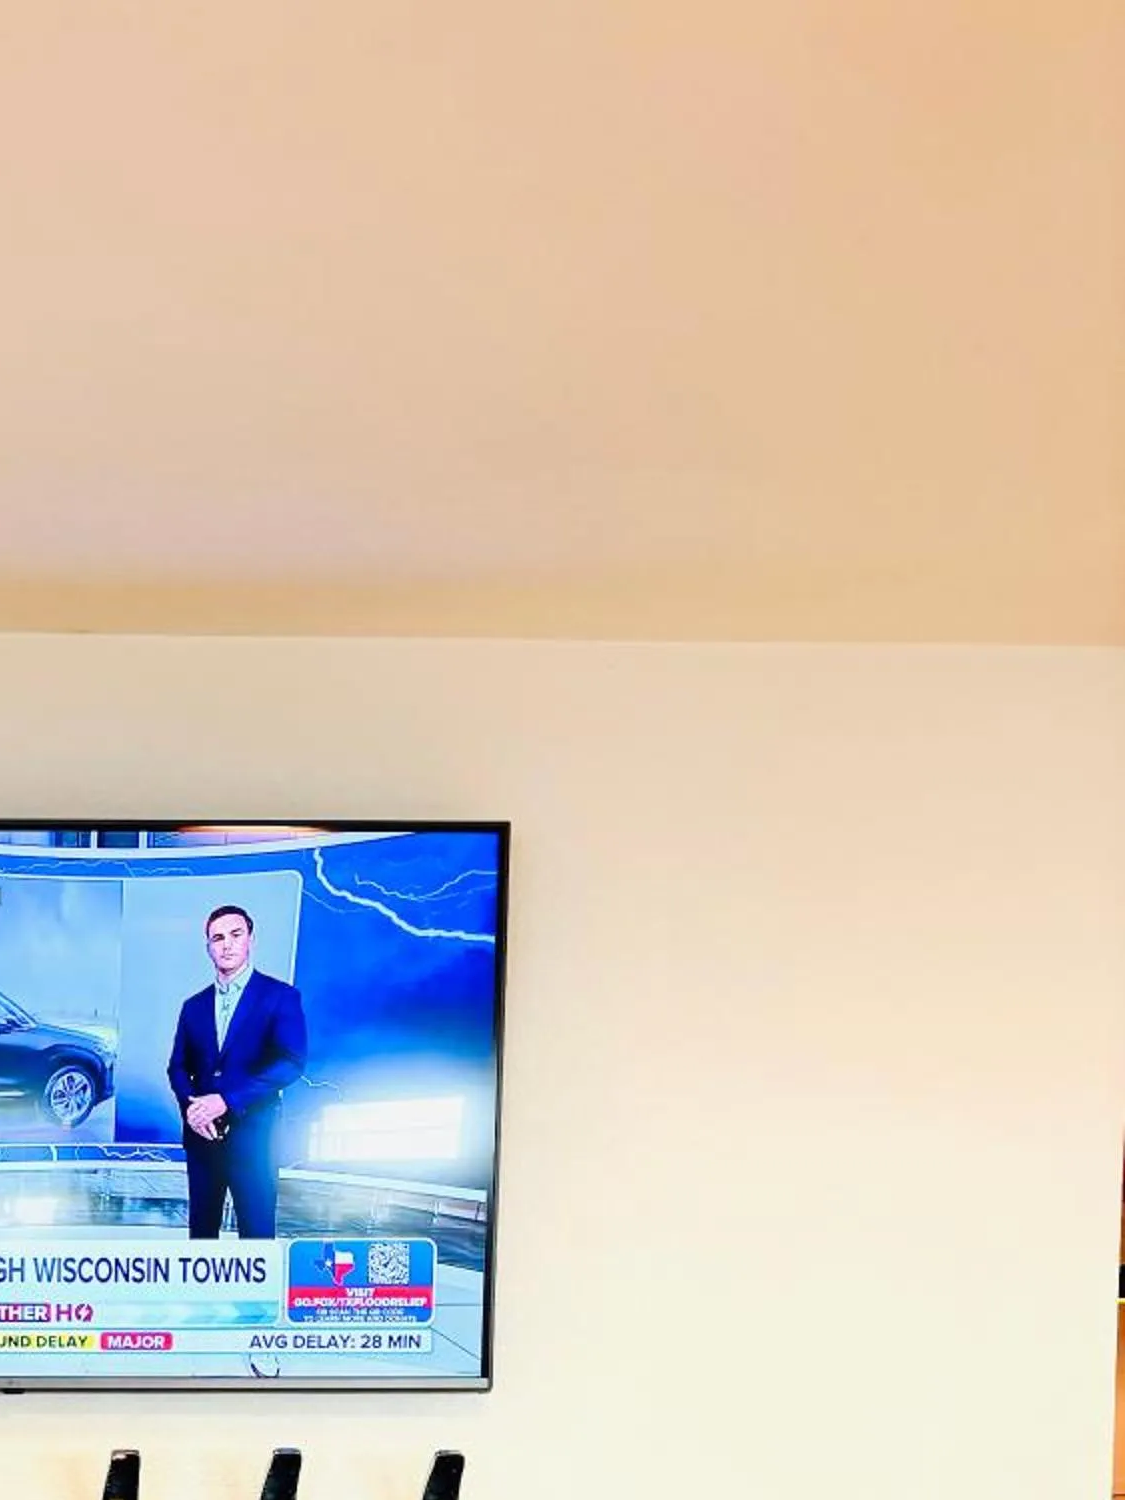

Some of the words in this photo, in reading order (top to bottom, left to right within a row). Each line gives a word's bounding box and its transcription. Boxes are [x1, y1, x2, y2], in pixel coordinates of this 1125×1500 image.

[33, 1256, 170, 1283] WISCONSIN
[178, 1257, 266, 1284] TOWNS
[36, 1335, 88, 1348] DELAY
[107, 1335, 165, 1349] MAJOR
[250, 1334, 288, 1349] AVG
[292, 1334, 355, 1349] DELAY:
[360, 1334, 382, 1349] 28
[388, 1334, 421, 1349] MIN
